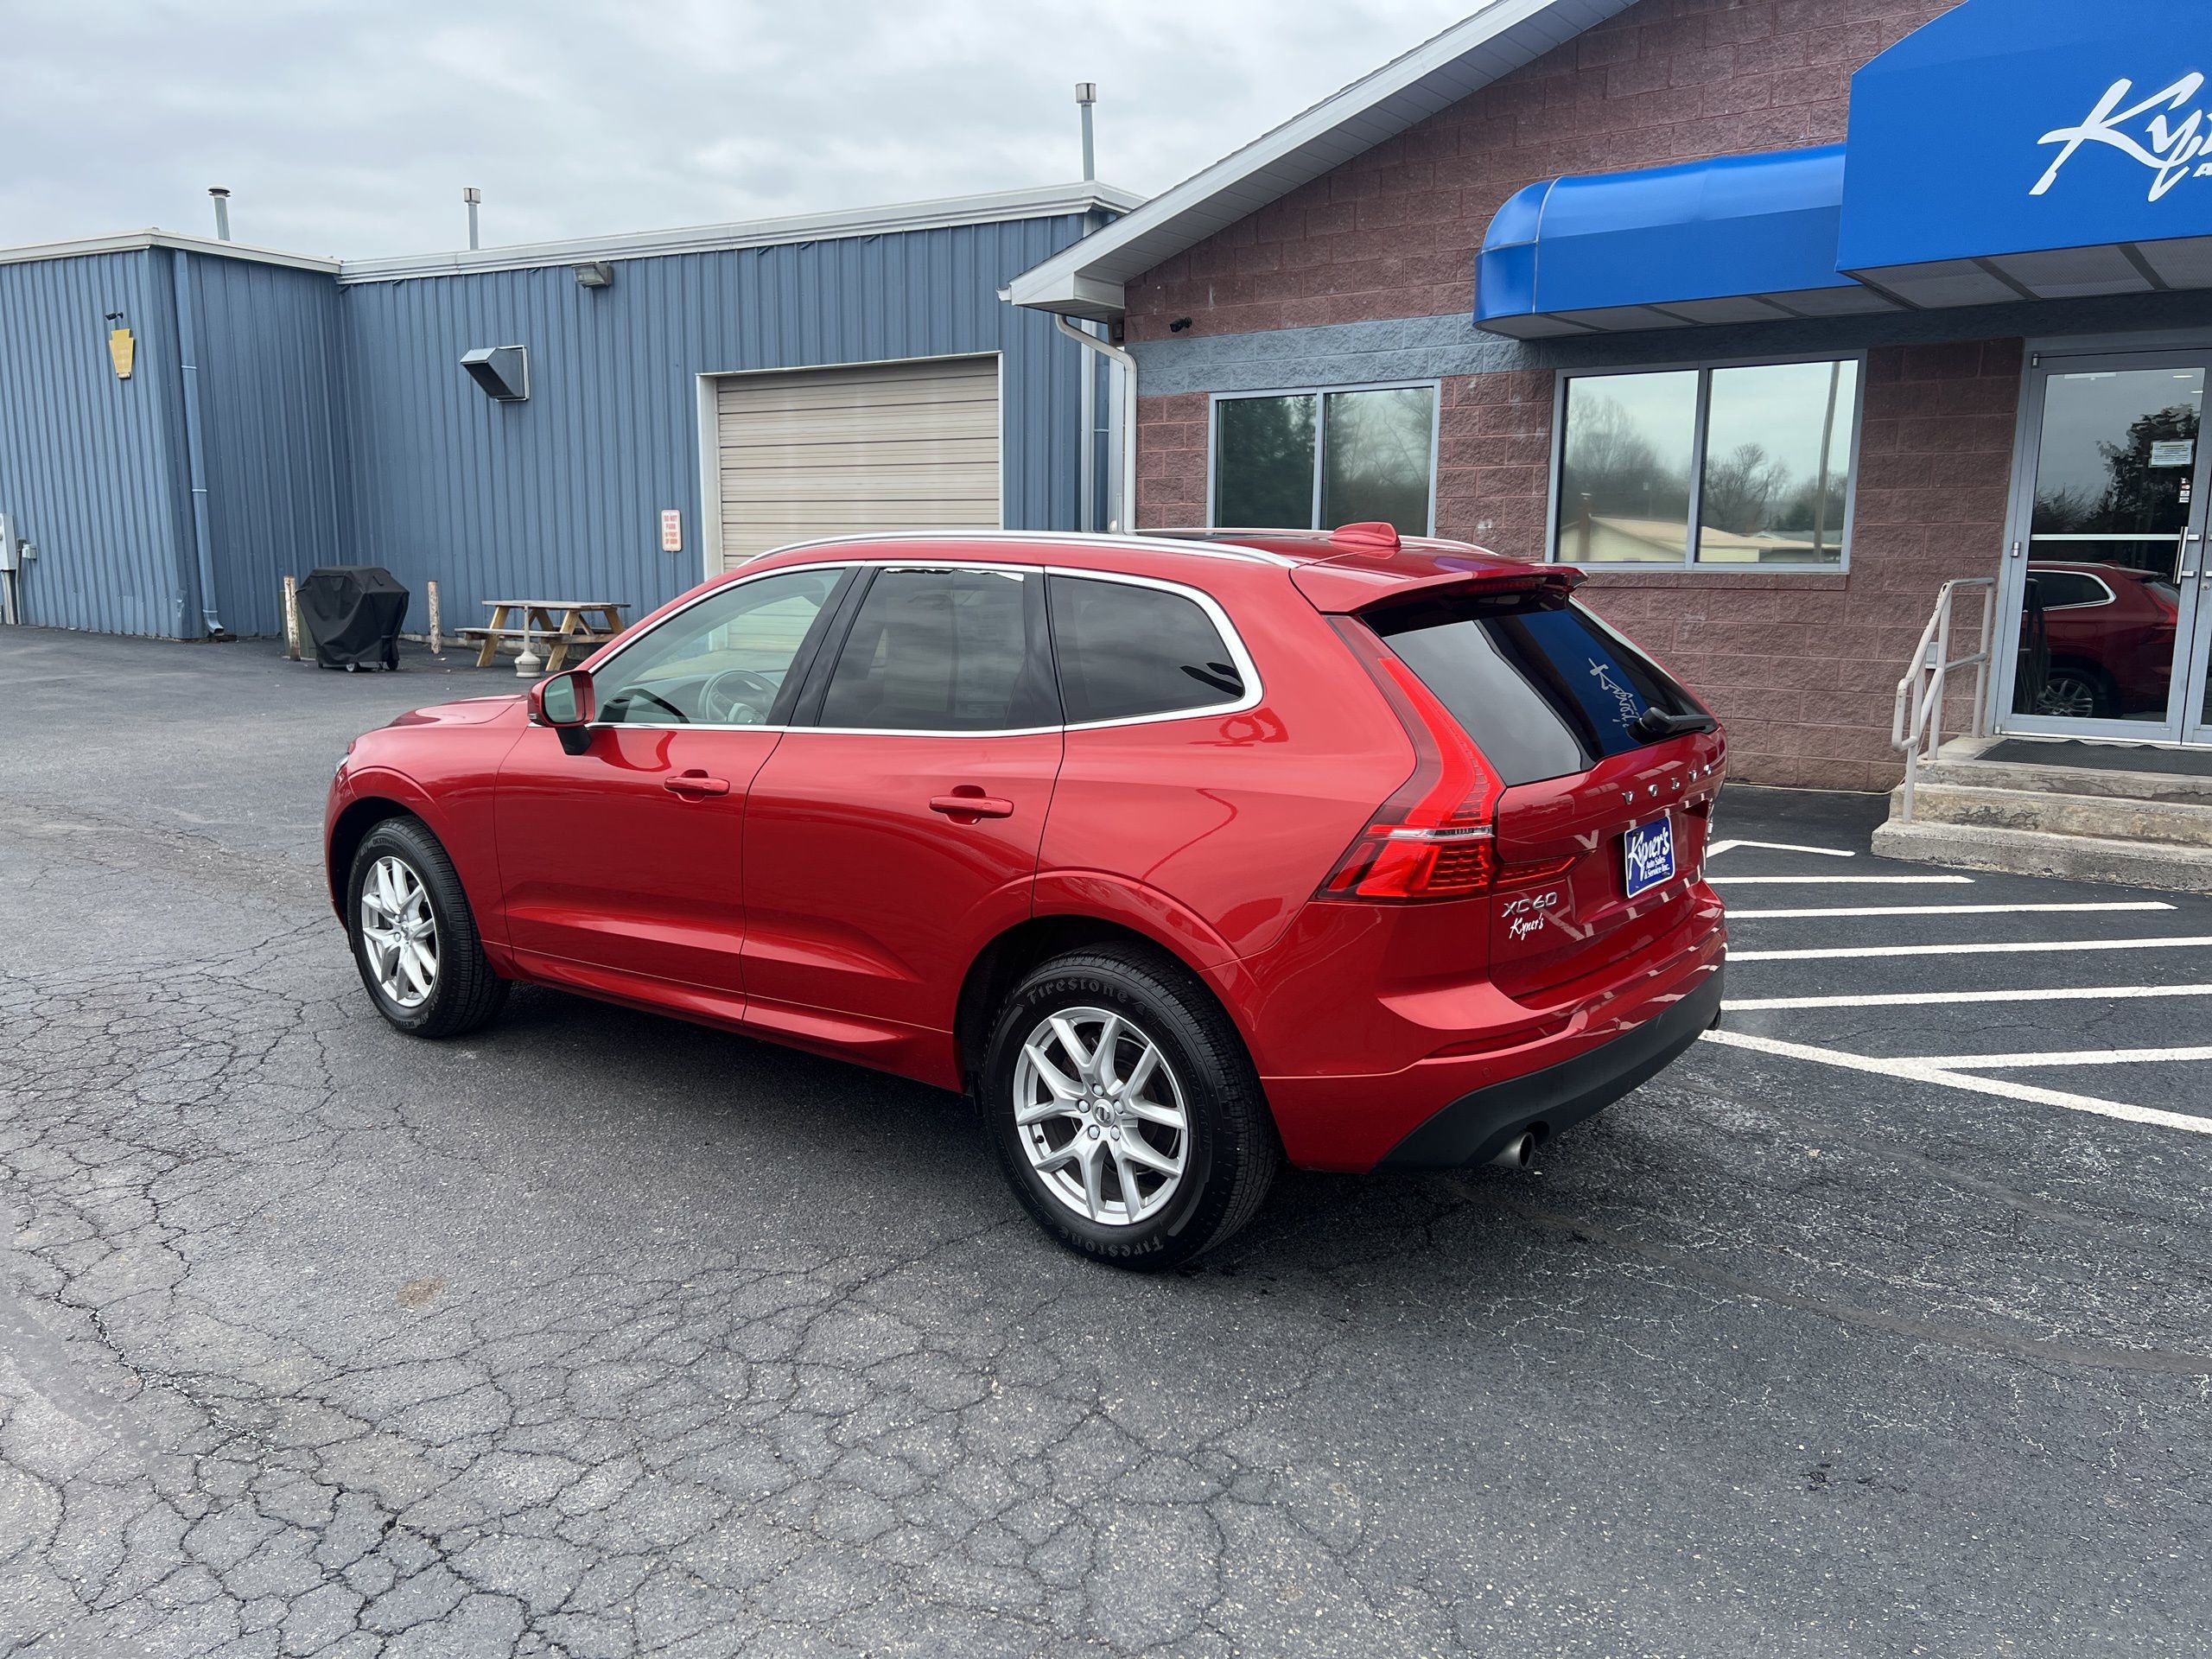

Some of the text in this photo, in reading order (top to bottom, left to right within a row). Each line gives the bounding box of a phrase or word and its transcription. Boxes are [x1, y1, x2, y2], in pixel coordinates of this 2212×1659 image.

[2028, 72, 2212, 202] Ky
[1622, 765, 1712, 804] VOLVO
[1628, 827, 1670, 881] Kyner's
[1501, 892, 1557, 918] XC60
[1509, 912, 1544, 941] Kyner's
[1027, 977, 1128, 1004] Firestone
[1057, 1224, 1165, 1258] Firestone
